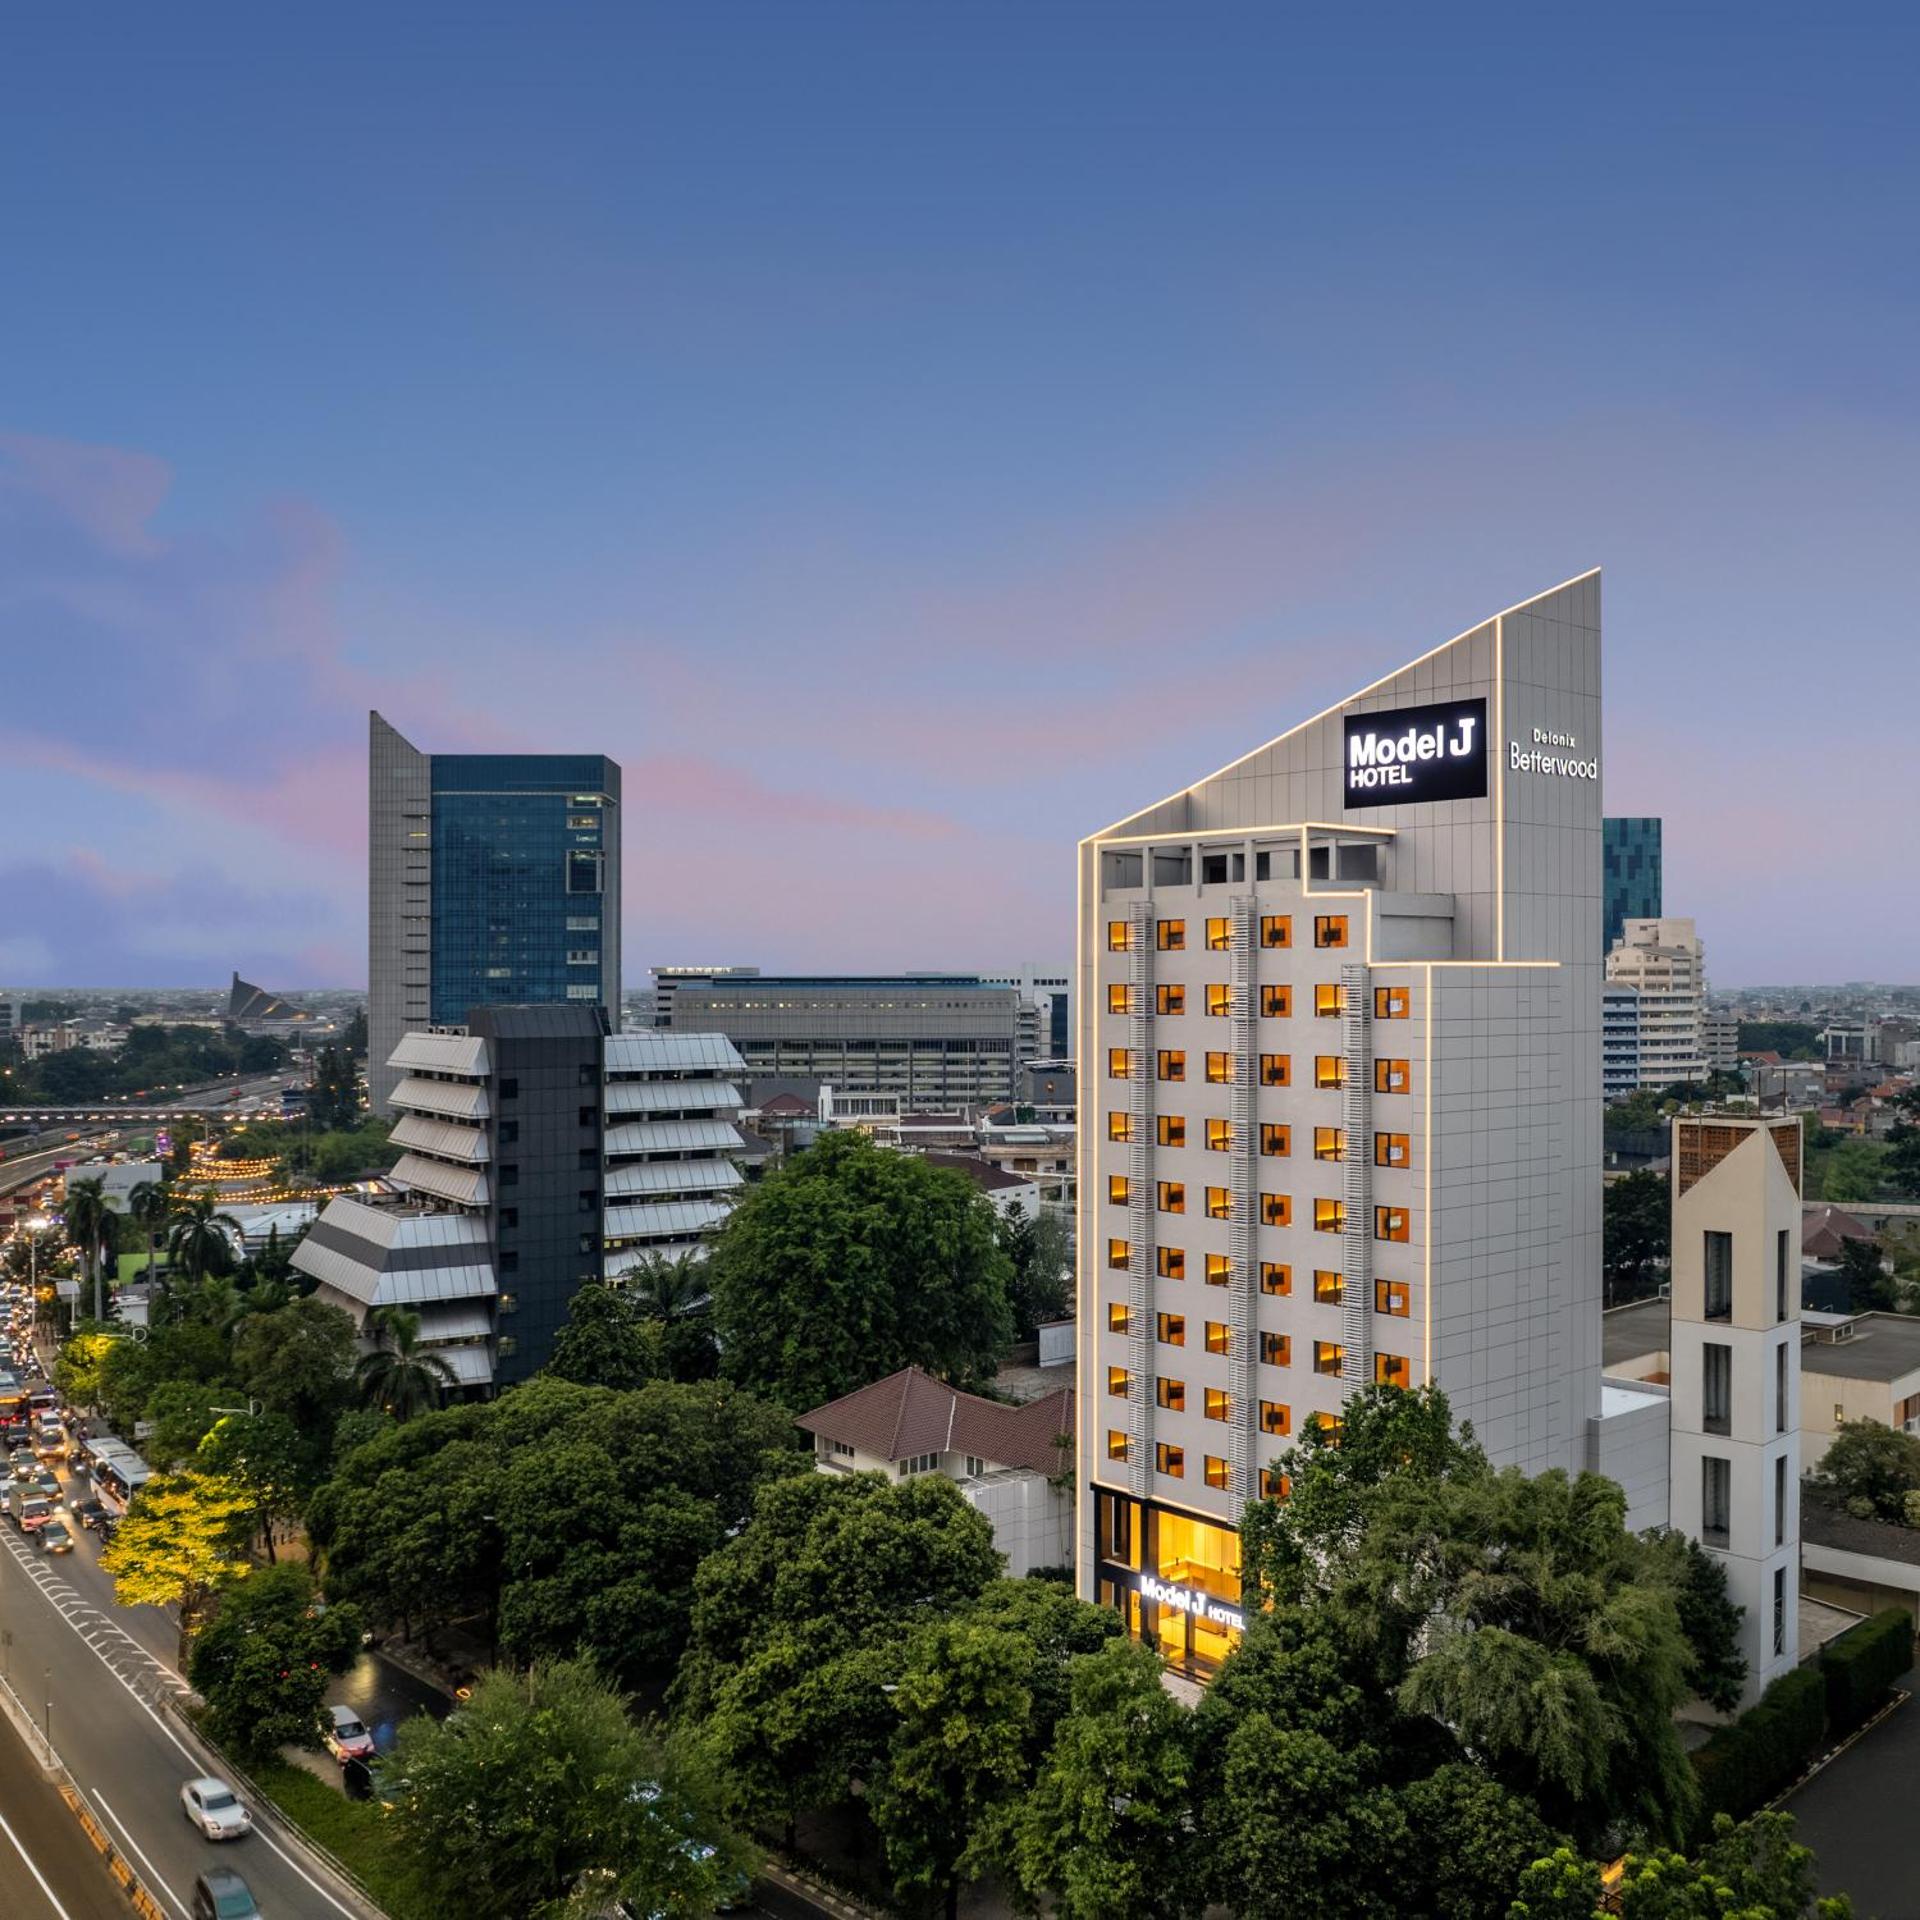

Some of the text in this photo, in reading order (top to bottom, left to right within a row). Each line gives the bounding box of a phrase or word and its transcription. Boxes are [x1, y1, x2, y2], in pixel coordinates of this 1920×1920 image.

[1350, 717, 1476, 767] Model J
[1533, 728, 1576, 748] Delonix
[1350, 764, 1413, 788] HOTEL
[1510, 741, 1598, 779] Betterwood
[1141, 1575, 1247, 1631] Model J HOTEL
